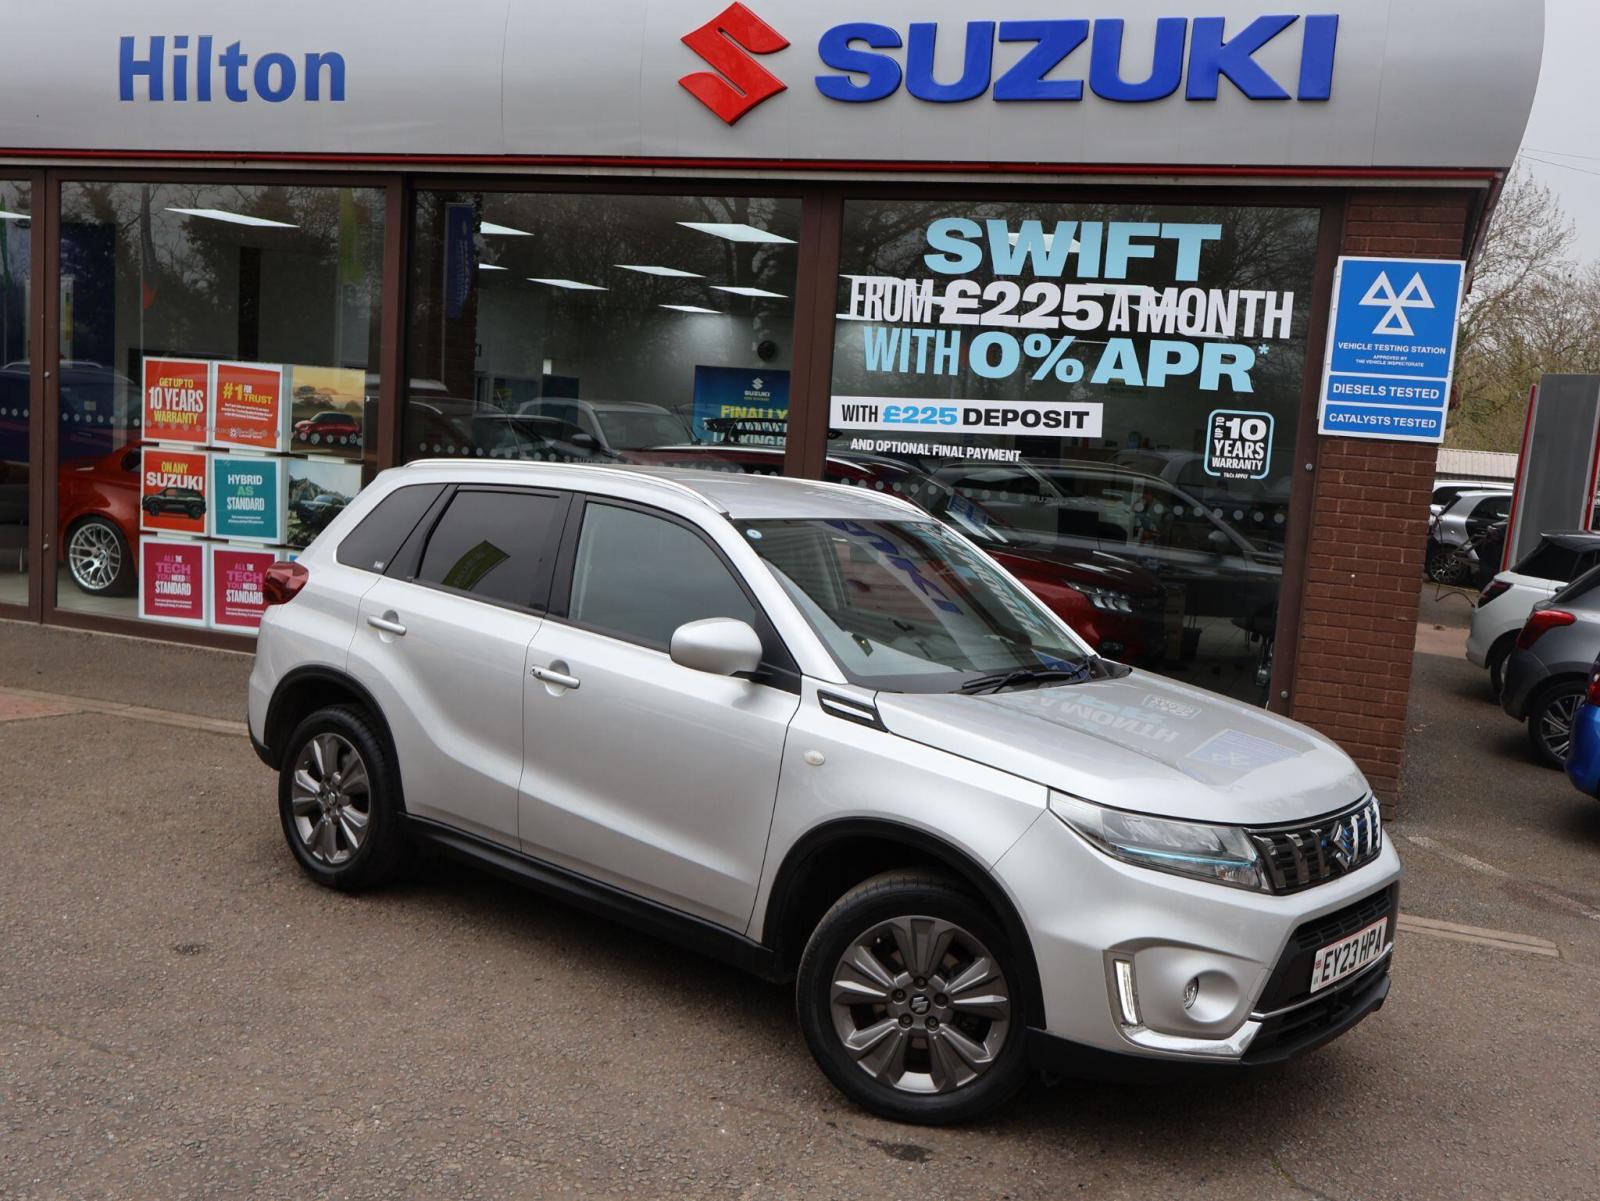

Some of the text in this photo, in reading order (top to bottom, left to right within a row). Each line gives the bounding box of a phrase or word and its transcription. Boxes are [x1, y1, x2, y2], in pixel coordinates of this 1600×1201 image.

[813, 13, 1339, 103] SUZUKI
[118, 35, 346, 103] Hilton
[923, 217, 1222, 282] SWIFT
[849, 276, 1295, 339] FROM £225 A MONTH
[863, 326, 961, 376] WITH
[968, 331, 1085, 383] 0%
[1338, 341, 1446, 355] VEHICLE TESTING STATION
[159, 377, 194, 388] GET UP TO
[223, 382, 243, 401] #1
[244, 393, 272, 404] TRUST
[1333, 383, 1439, 399] DIESELS TESTED
[149, 386, 204, 413] 10 YEARS
[154, 410, 198, 425] WARRANTY
[841, 404, 1089, 429] WITH £225 DEPOSIT
[1329, 413, 1437, 429] CATALYSTS TESTED
[1214, 416, 1225, 438] UP TO
[1225, 417, 1267, 441] 10
[850, 438, 1021, 462] AND OPTIONAL FINAL PAYMENT
[1213, 439, 1265, 459] YEARS
[161, 462, 188, 474] ON ANY
[1212, 457, 1263, 470] WARRANTY
[146, 471, 203, 491] SUZUKI
[228, 474, 263, 485] HYBRID
[237, 486, 254, 497] AS
[227, 496, 265, 511] STANDARD
[155, 562, 191, 575] TECH
[226, 570, 263, 583] TECH
[155, 580, 191, 596] STANDARD
[226, 589, 264, 605] STANDARD
[1322, 925, 1383, 982] EY23 HPA
